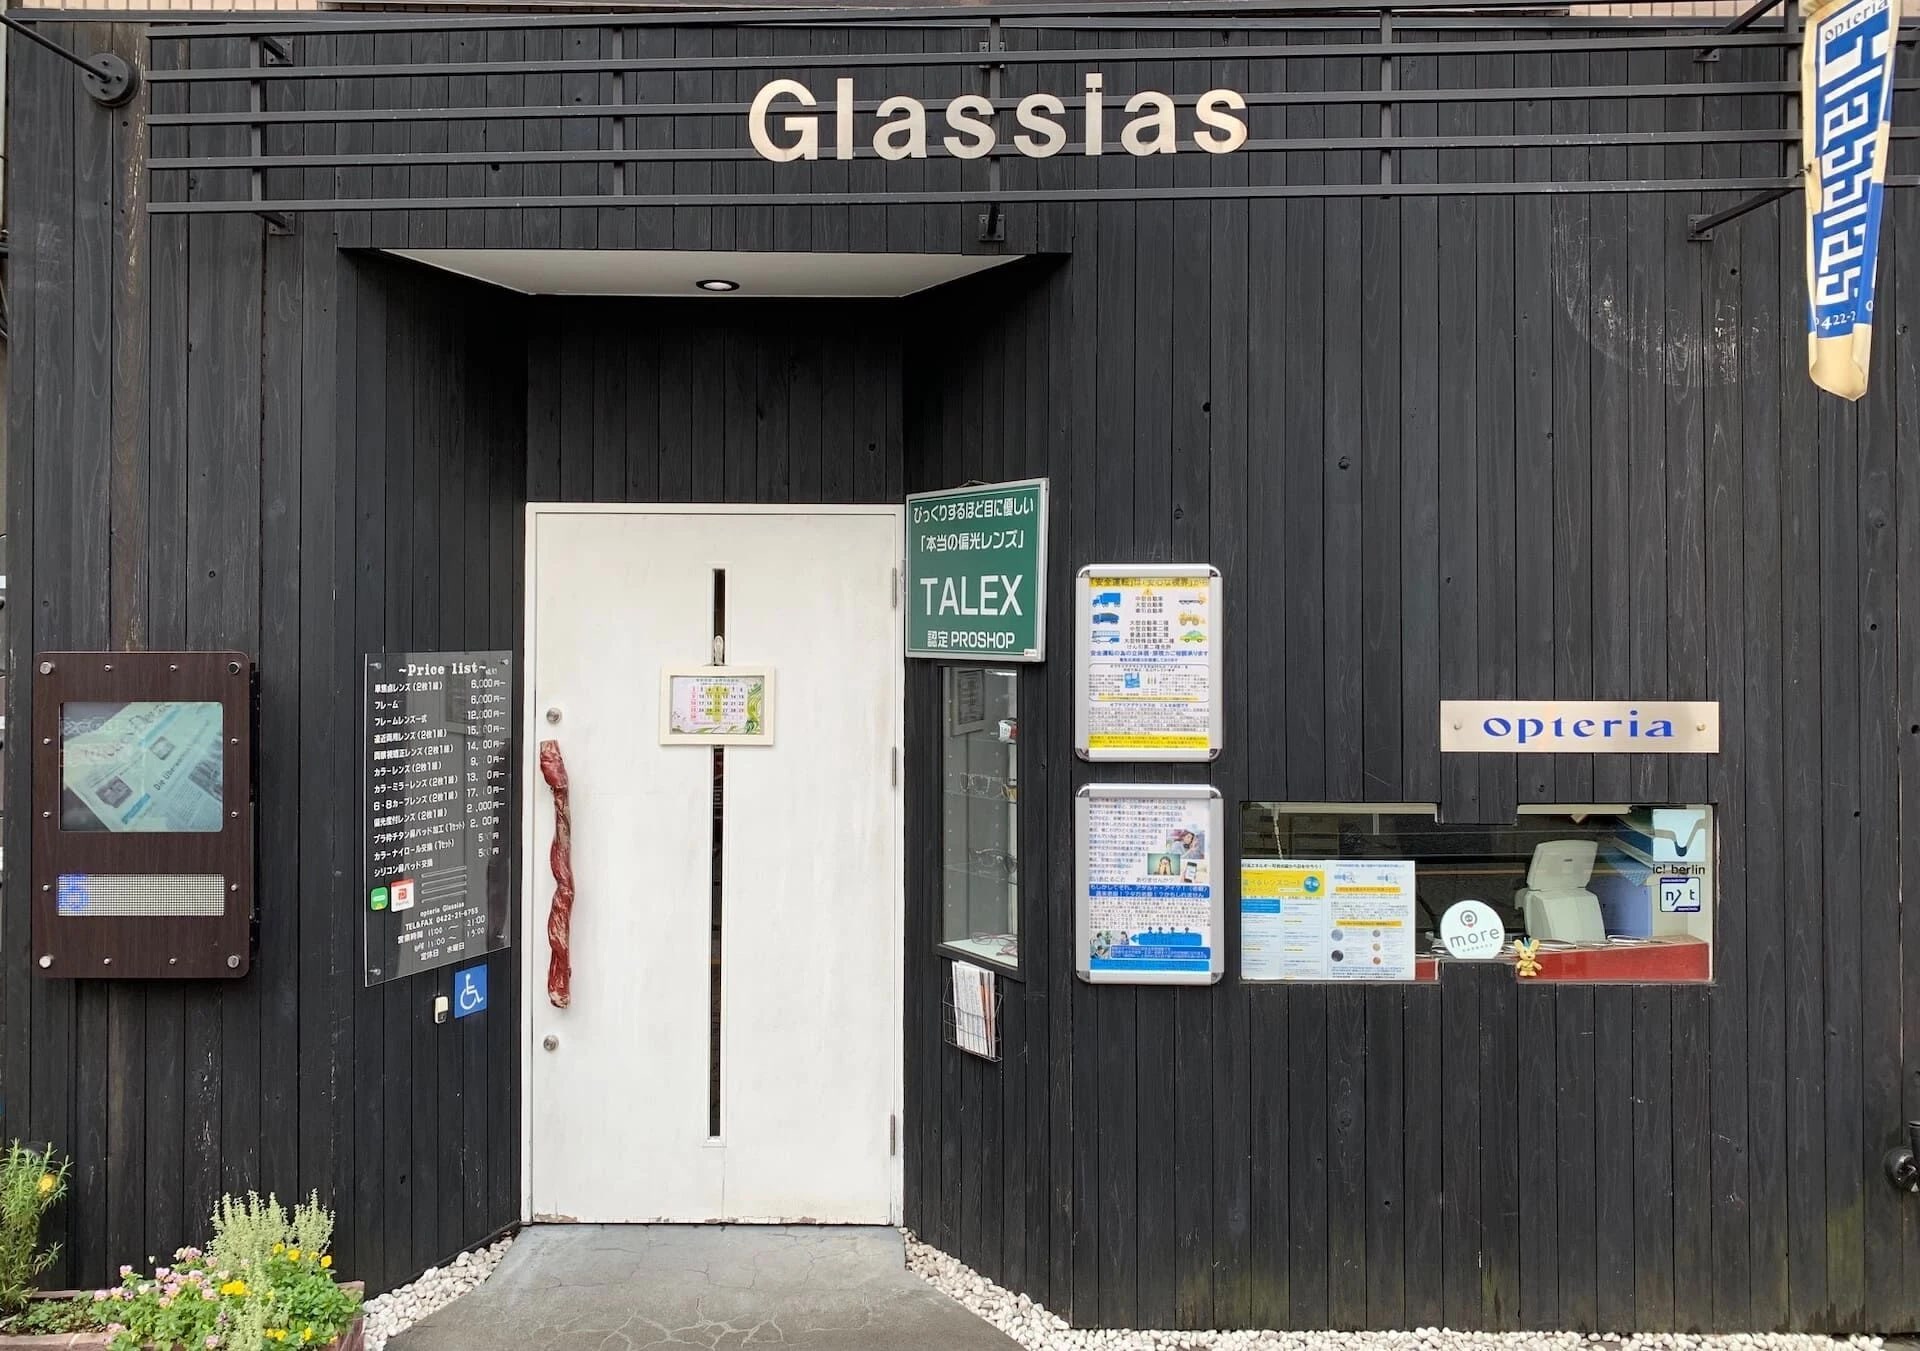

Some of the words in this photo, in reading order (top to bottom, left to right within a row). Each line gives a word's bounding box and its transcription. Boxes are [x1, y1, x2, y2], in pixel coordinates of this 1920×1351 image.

[748, 72, 1248, 162] Glassias
[914, 497, 1034, 523] びっくりするほど目に優しい
[921, 530, 1024, 552] 「本当の偏光レンズ」
[920, 574, 1024, 616] TALEX
[927, 630, 948, 648] 認定
[951, 631, 1015, 649] PROSHOP
[374, 701, 399, 710] フレーム
[1483, 710, 1675, 744] opteria
[1671, 864, 1705, 875] berlin
[1450, 928, 1500, 947] more
